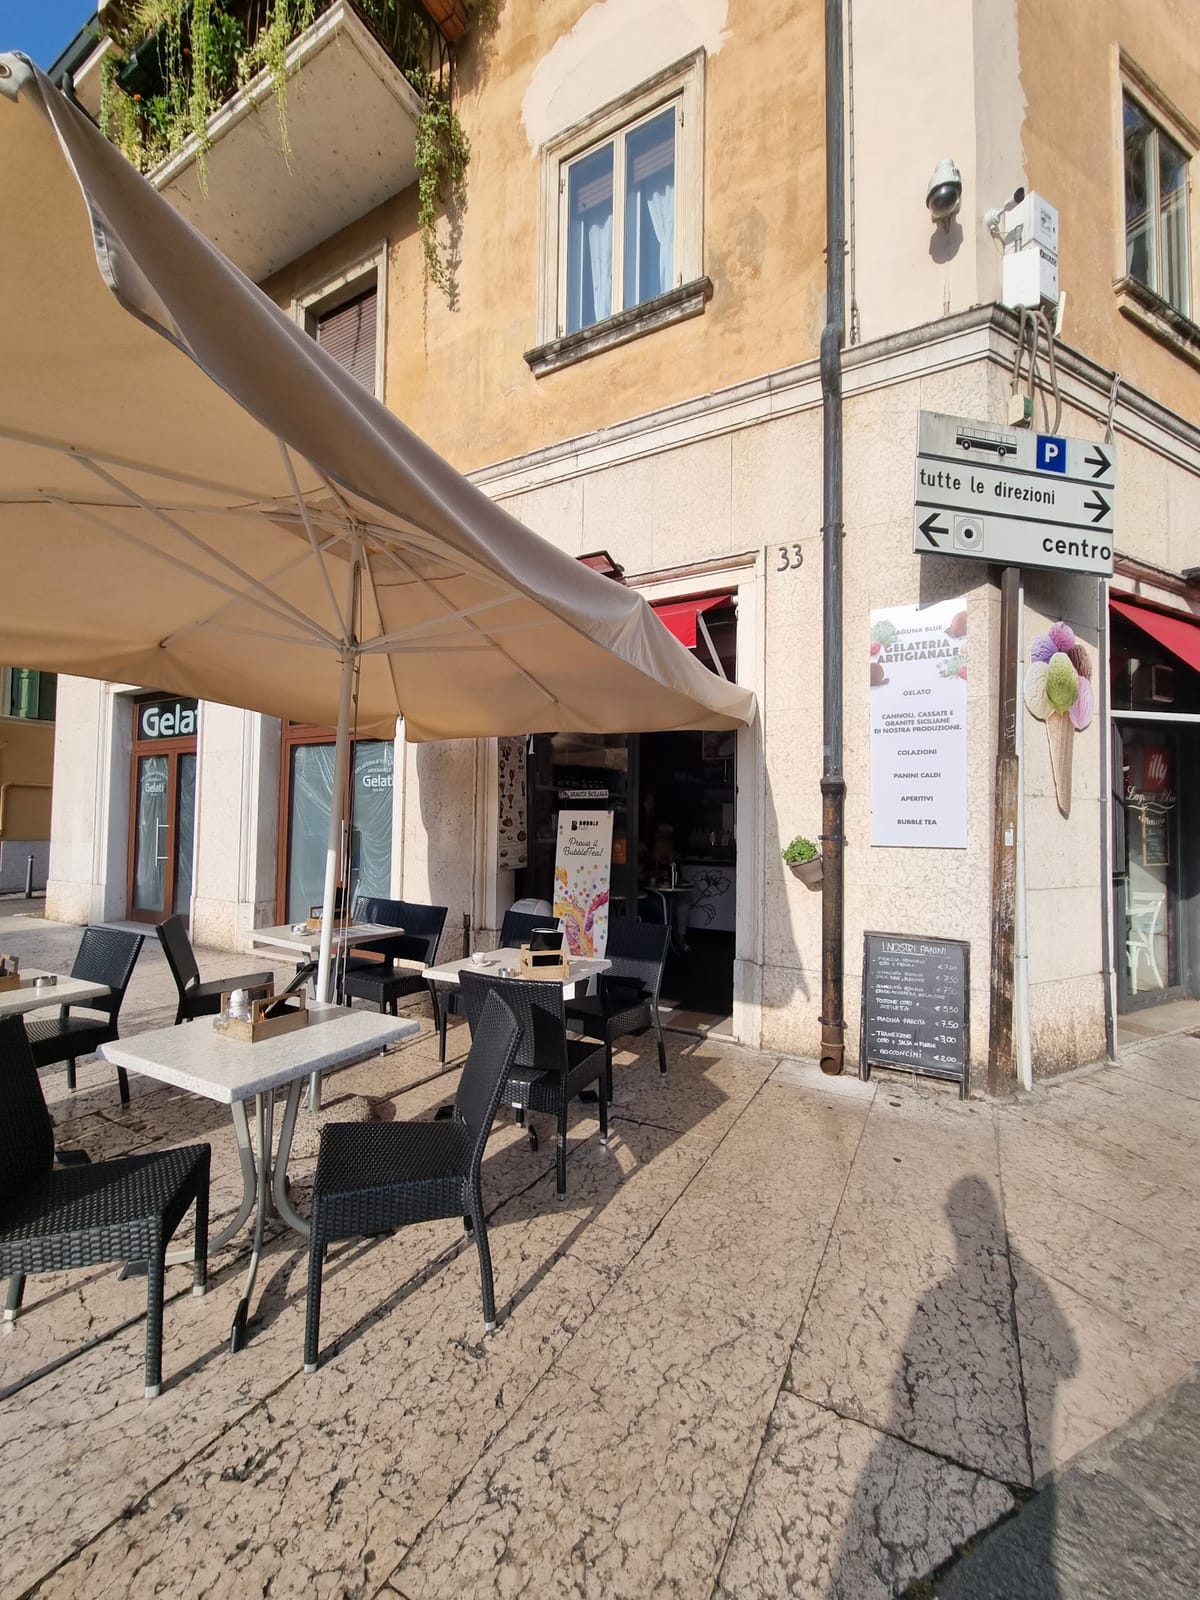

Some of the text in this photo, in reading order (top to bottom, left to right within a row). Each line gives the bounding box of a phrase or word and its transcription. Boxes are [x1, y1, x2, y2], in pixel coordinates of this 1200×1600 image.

[1044, 443, 1059, 463] P
[920, 468, 1056, 505] tutte le direzioni
[1042, 537, 1112, 561] centro
[776, 543, 804, 572] 33
[884, 638, 950, 653] GELATERIA
[877, 647, 960, 664] ARTIGIANALE
[902, 688, 932, 696] GELATO
[142, 703, 198, 737] Gela
[884, 717, 950, 727] GRANITE SICILIANE
[912, 724, 962, 733] PRODUZIONE.
[896, 748, 937, 756] COLAZIONI
[1148, 754, 1168, 784] illy
[362, 774, 394, 787] Gelat
[144, 783, 164, 793] Gelati
[568, 837, 591, 847] Prova
[886, 942, 917, 952] NOSTRI
[920, 945, 947, 956] PANINI
